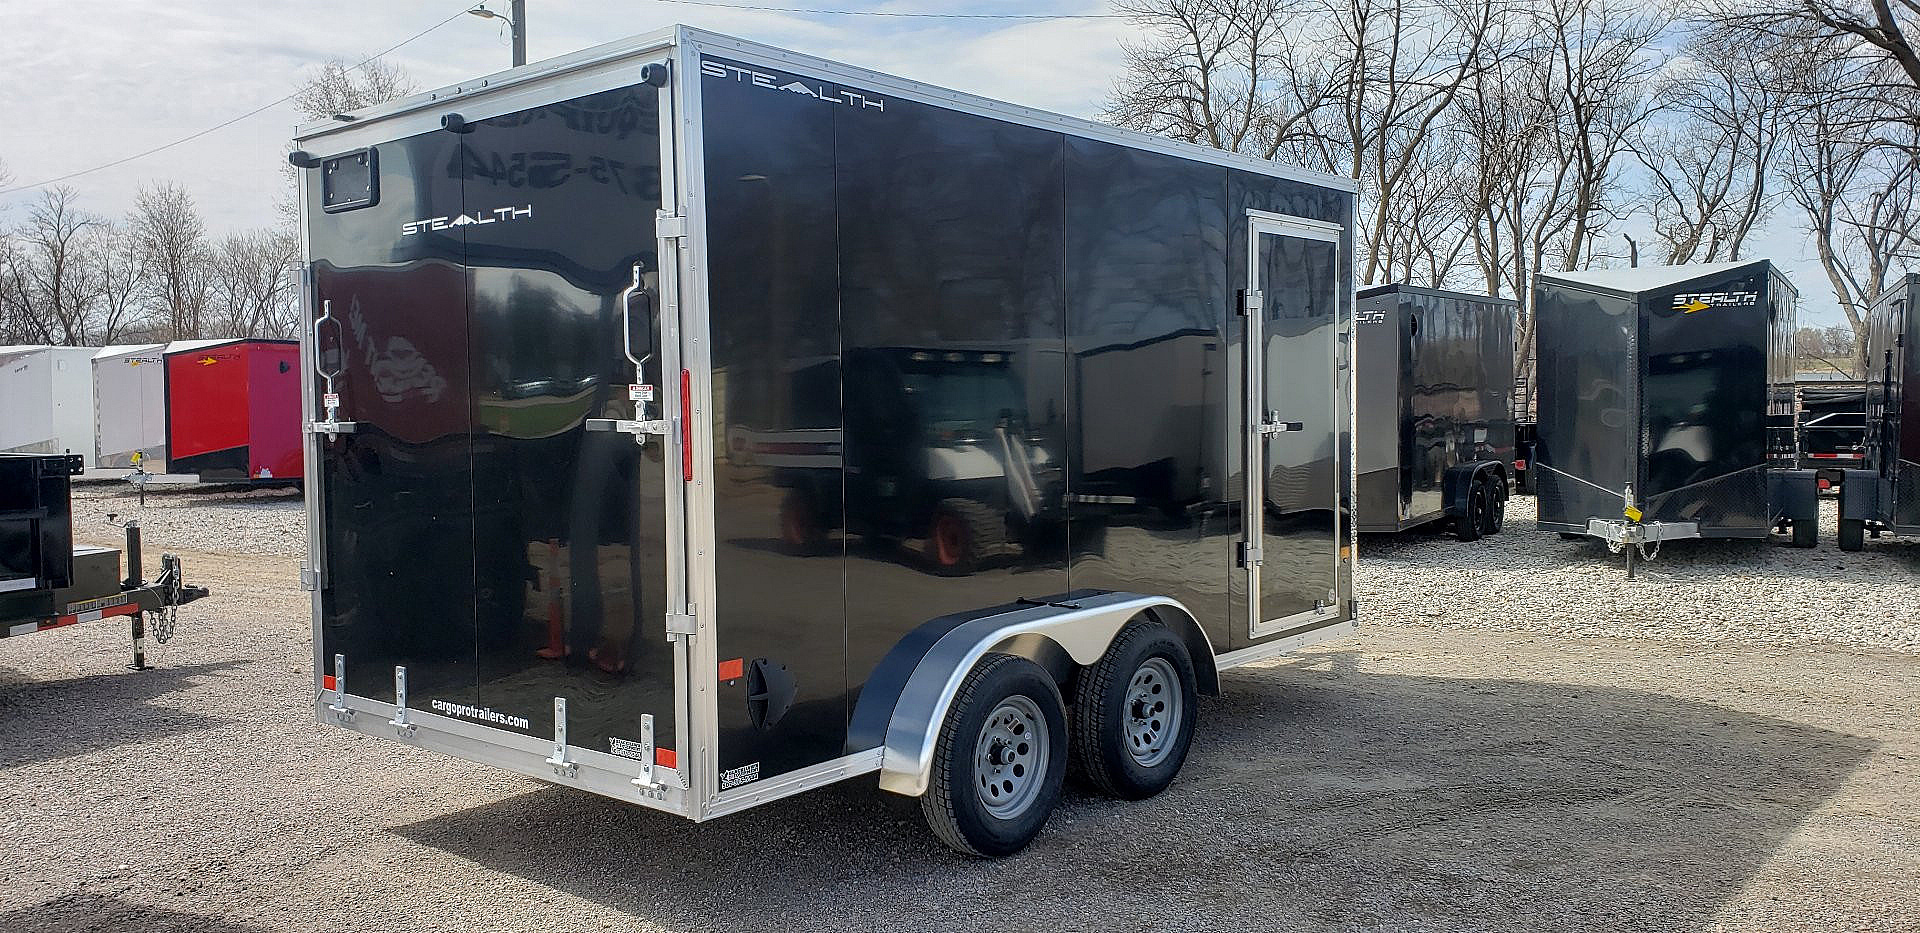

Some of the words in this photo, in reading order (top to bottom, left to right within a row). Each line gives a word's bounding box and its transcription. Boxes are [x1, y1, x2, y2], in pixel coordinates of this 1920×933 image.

[701, 60, 885, 112] STEALTH
[402, 204, 532, 236] STEALTH
[1673, 291, 1758, 304] STEALTH
[431, 699, 529, 729] cargoprotrailers.com
